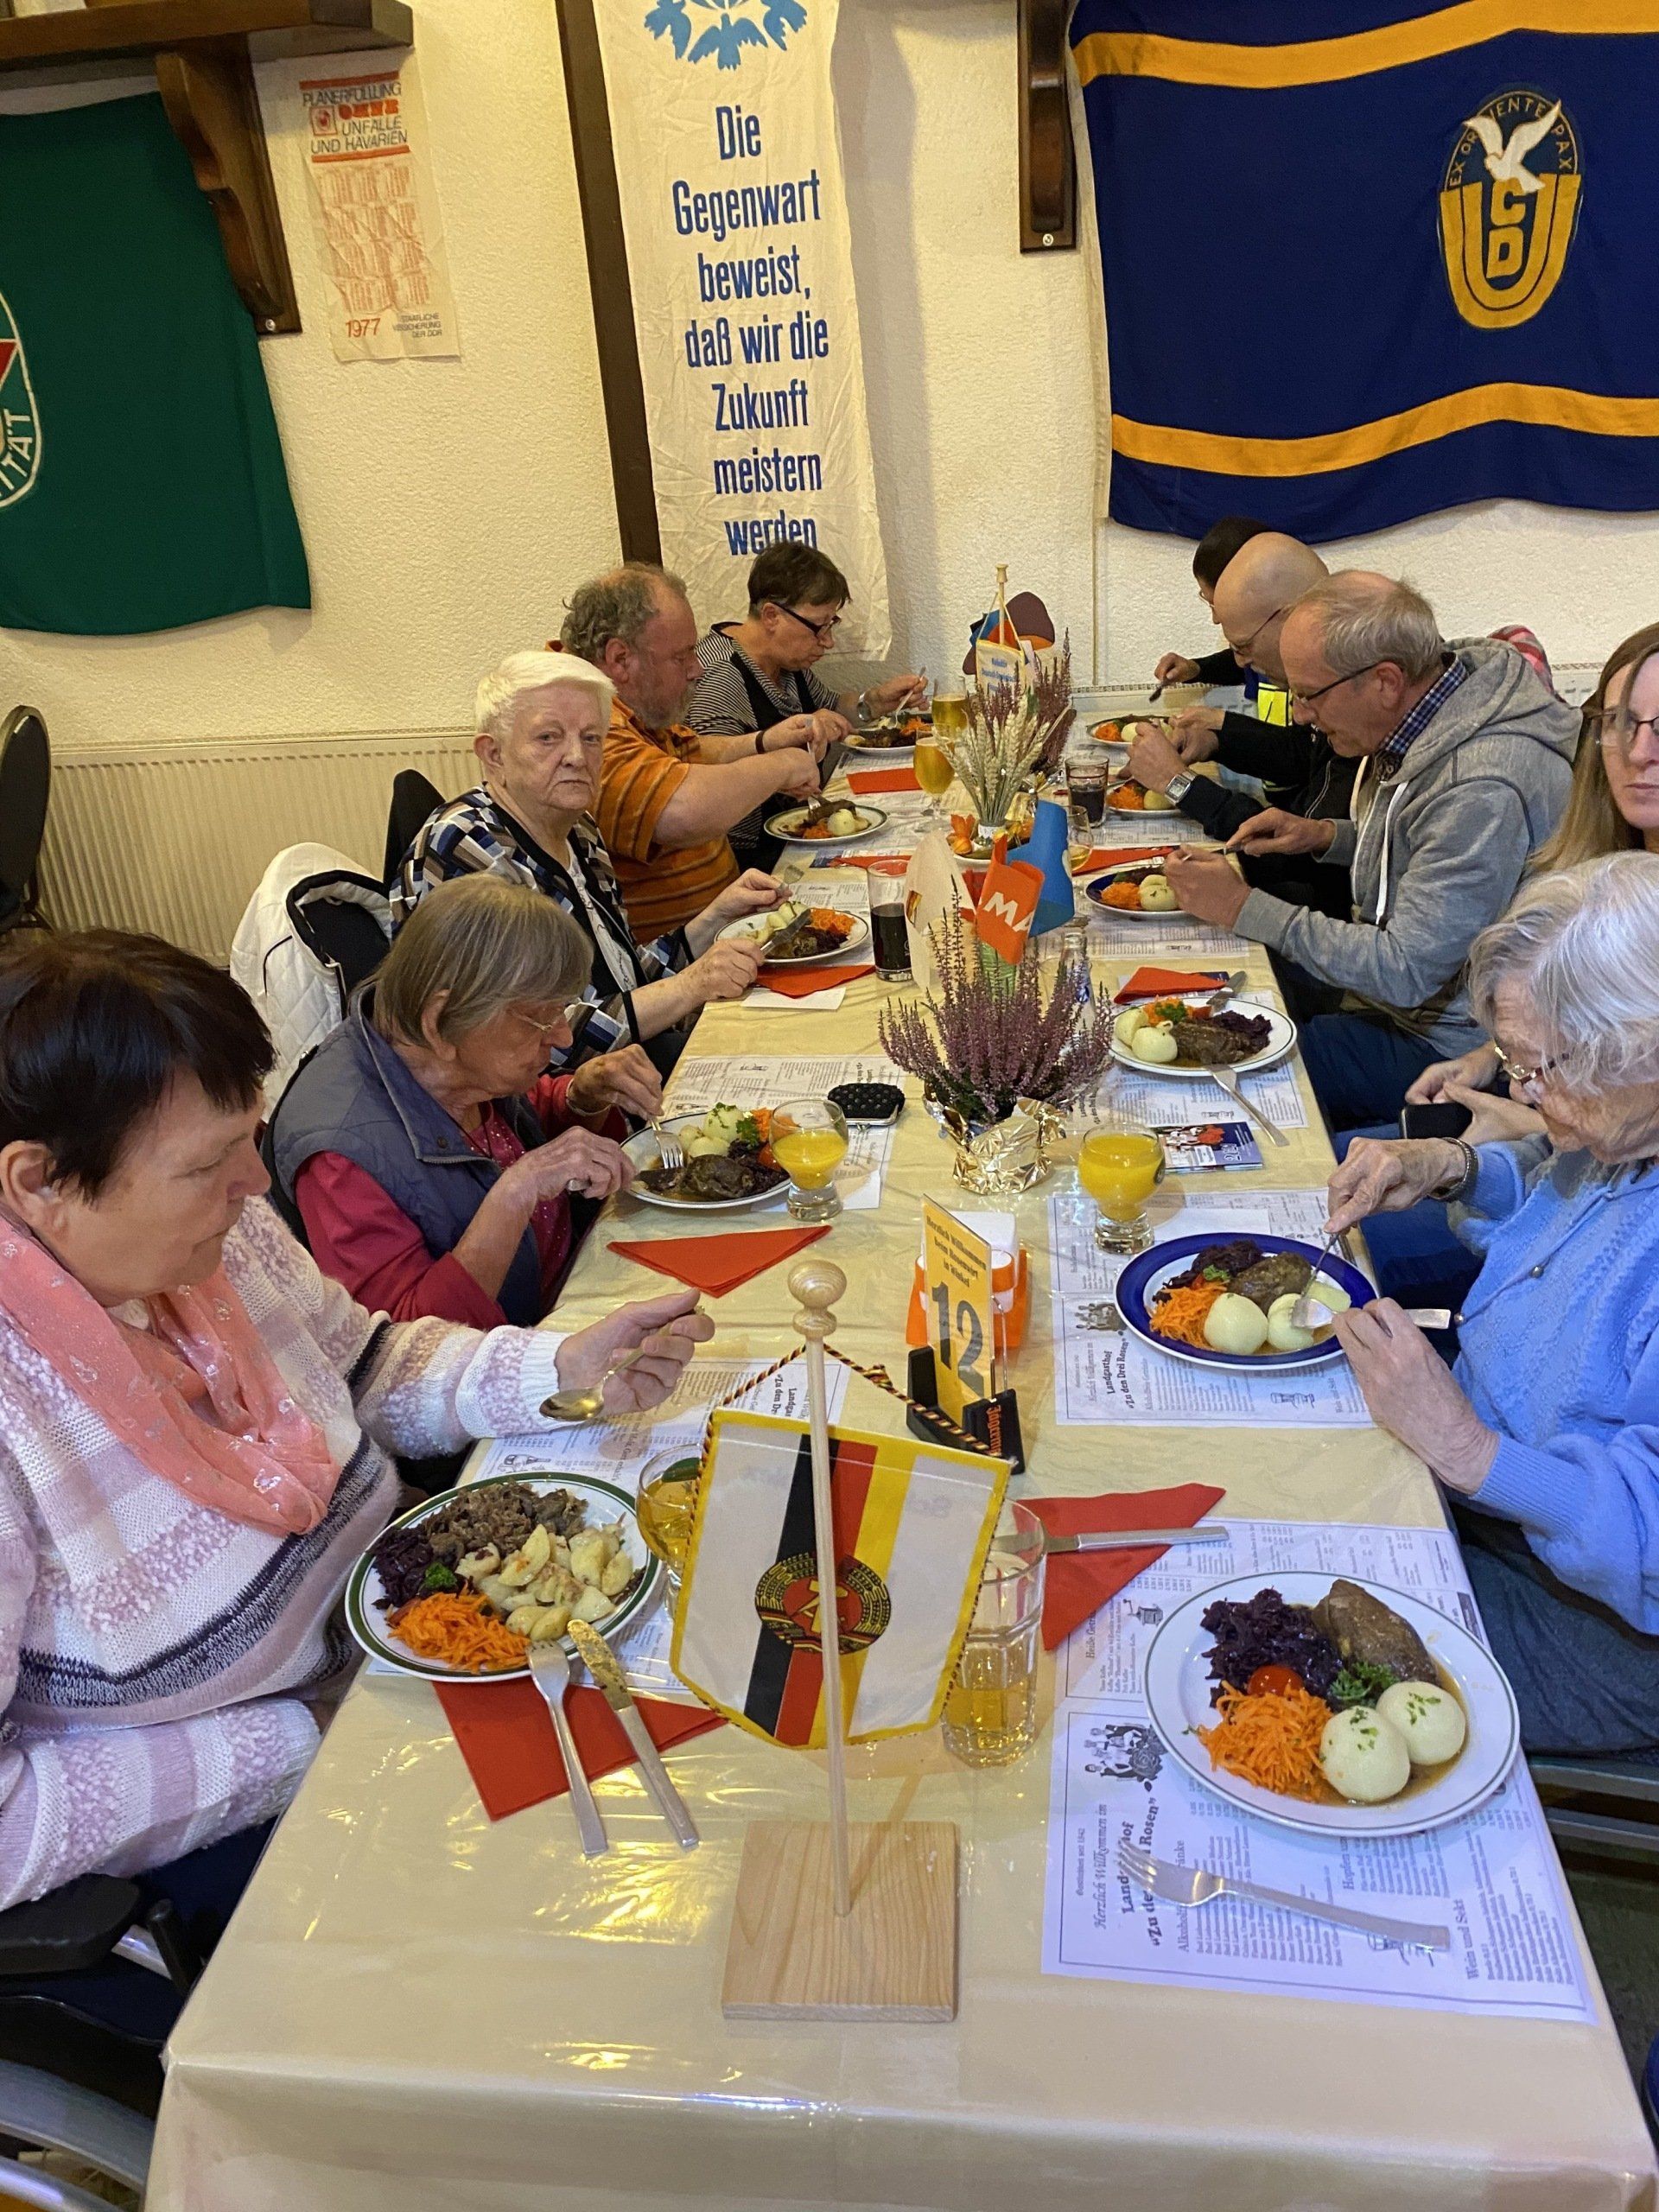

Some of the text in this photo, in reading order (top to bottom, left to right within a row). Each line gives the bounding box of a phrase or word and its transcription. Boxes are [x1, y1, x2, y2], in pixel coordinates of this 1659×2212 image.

[311, 130, 408, 154] UND HAVARIEN
[715, 105, 761, 160] Die
[1449, 161, 1465, 187] EX
[1551, 124, 1573, 170] PAX
[672, 169, 821, 242] Gegenwart
[697, 245, 810, 302] beweist,
[346, 318, 380, 338] 1977
[684, 310, 830, 368] daß wir die
[711, 378, 809, 431] Zukunft
[714, 448, 823, 495] meistern
[931, 1281, 985, 1399] 12
[785, 1388, 797, 1417] Landgas
[1116, 1821, 1135, 1915] Landhof
[1093, 1883, 1107, 1929] Herzlich
[1141, 1890, 1155, 1913] de
